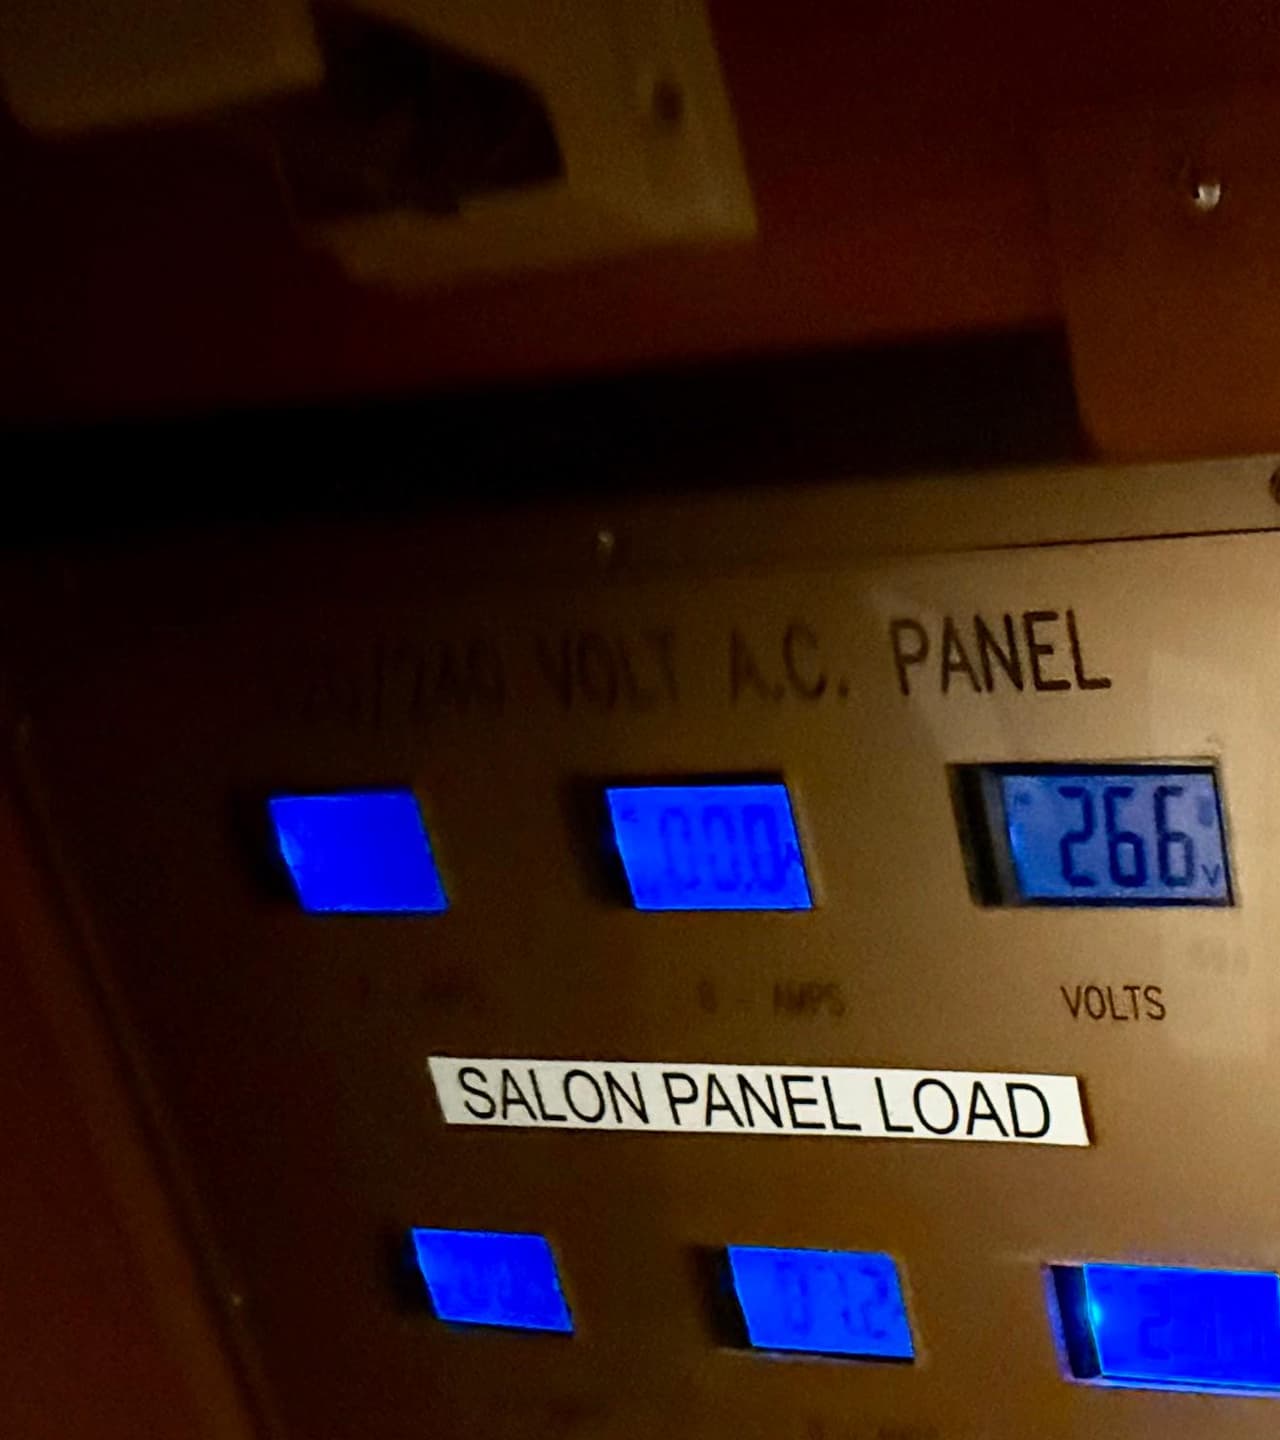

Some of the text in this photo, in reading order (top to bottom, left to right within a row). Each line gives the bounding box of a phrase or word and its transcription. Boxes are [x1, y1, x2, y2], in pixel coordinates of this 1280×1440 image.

[726, 622, 850, 704] A.C.
[892, 608, 1112, 696] PANEL
[1056, 784, 1196, 892] 266
[1060, 984, 1166, 1021] VOLTS
[458, 1067, 1051, 1138] SALON PANEL LOAD
